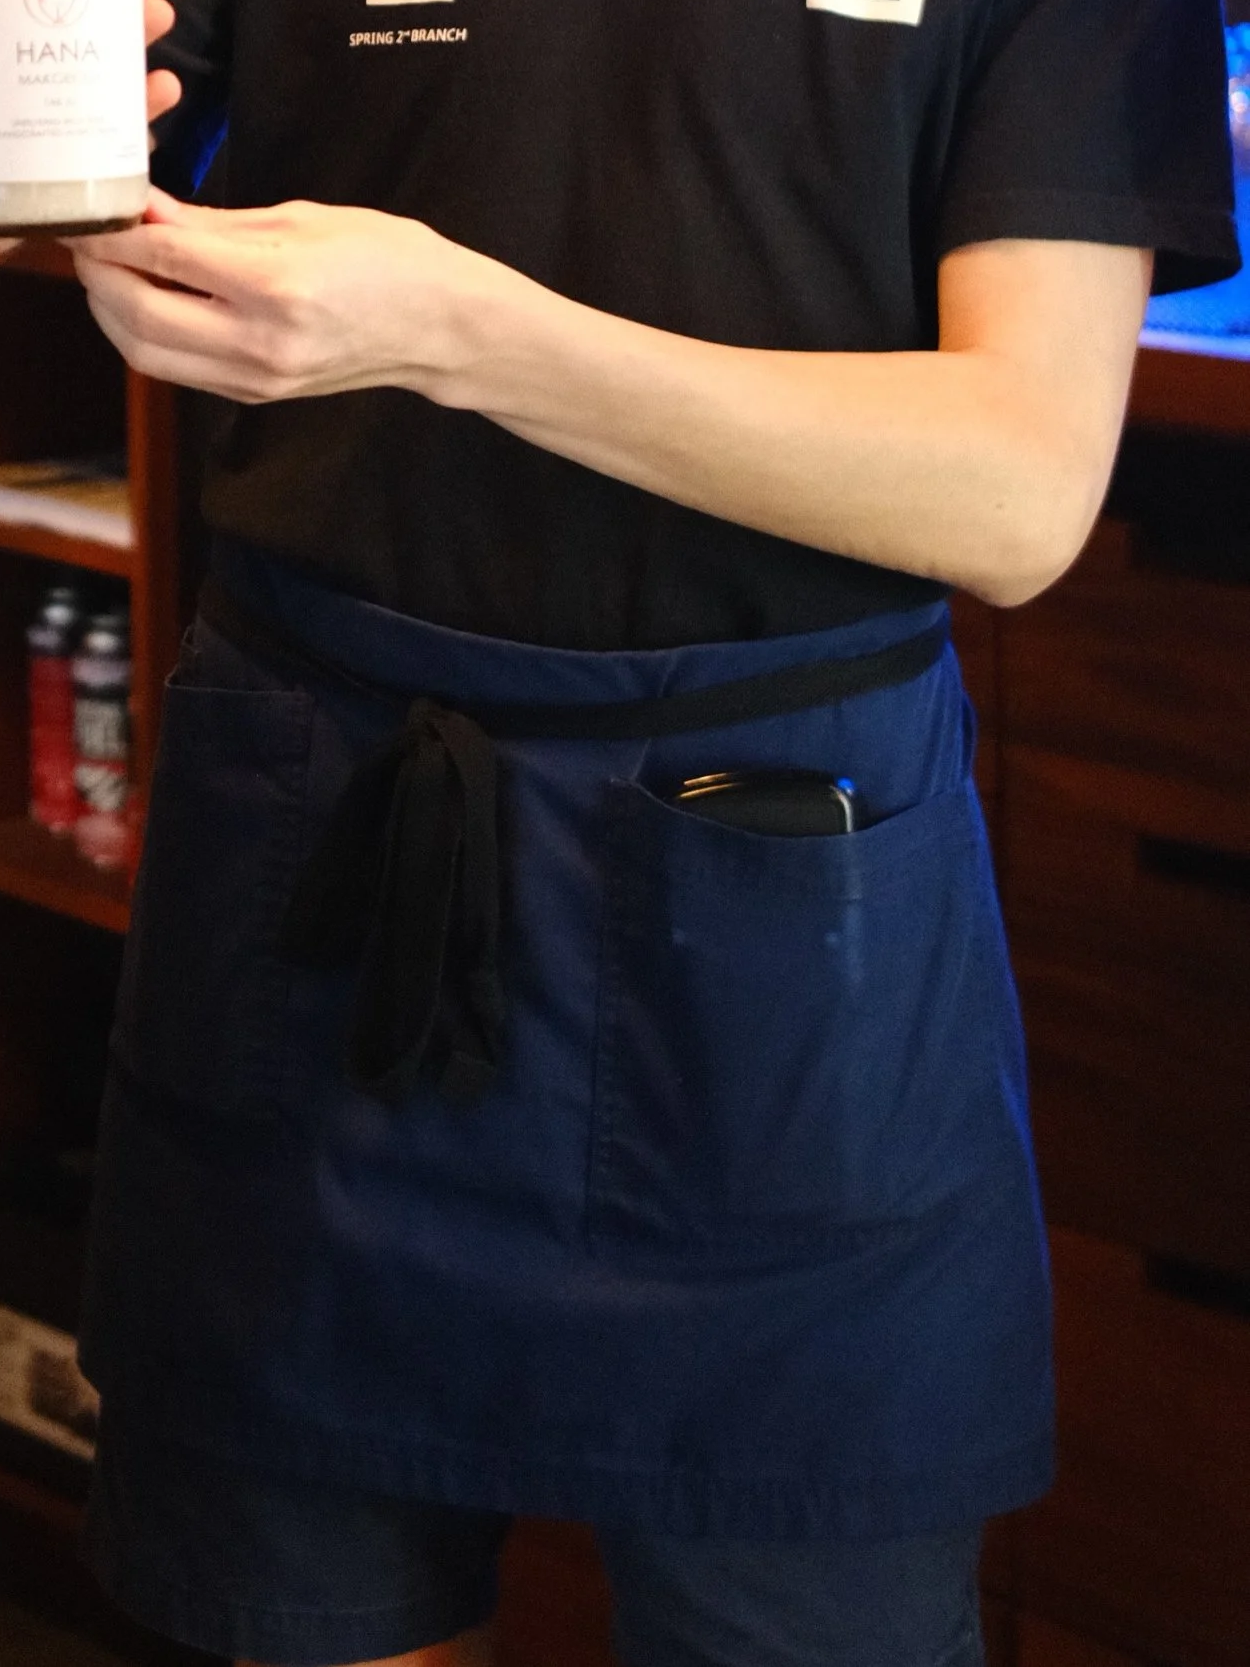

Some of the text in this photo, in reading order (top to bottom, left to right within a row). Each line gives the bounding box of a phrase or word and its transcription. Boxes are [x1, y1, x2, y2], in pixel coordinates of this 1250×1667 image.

[349, 31, 394, 47] SPRING
[410, 27, 467, 43] BRANCH
[16, 39, 100, 65] HANA
